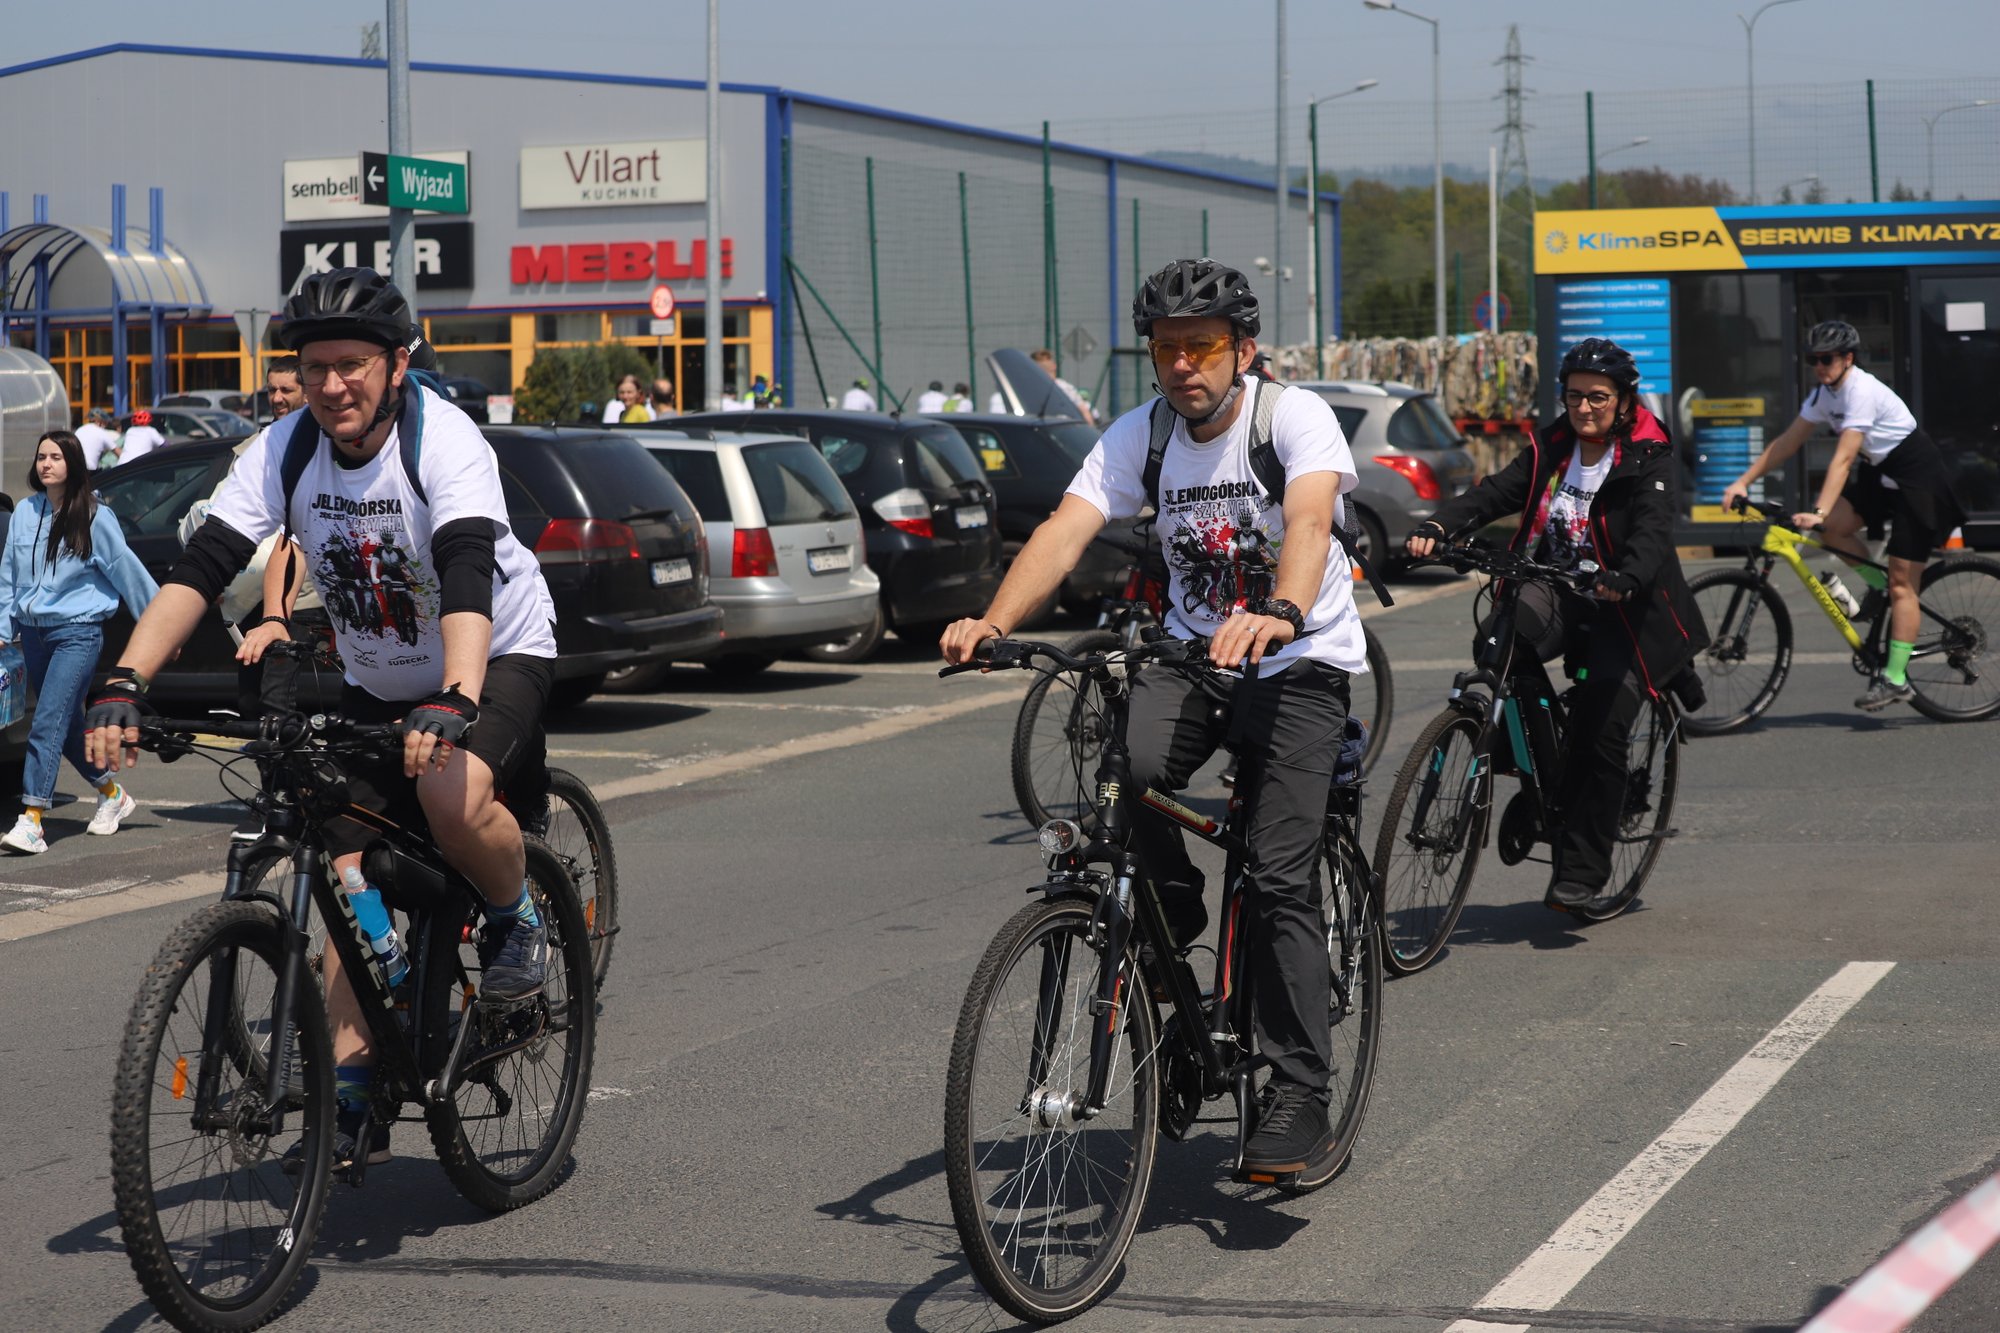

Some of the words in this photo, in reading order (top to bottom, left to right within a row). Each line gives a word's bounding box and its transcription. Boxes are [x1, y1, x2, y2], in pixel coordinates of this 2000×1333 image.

[564, 149, 660, 184] Vilart
[401, 165, 453, 202] Wyjazd
[582, 187, 658, 200] KUCHNIE
[1577, 230, 1724, 250] KlimaSPA
[1739, 227, 1852, 246] SERWIS
[511, 239, 733, 284] MEBLE
[1165, 480, 1260, 505] JLENIOGÓRSKA
